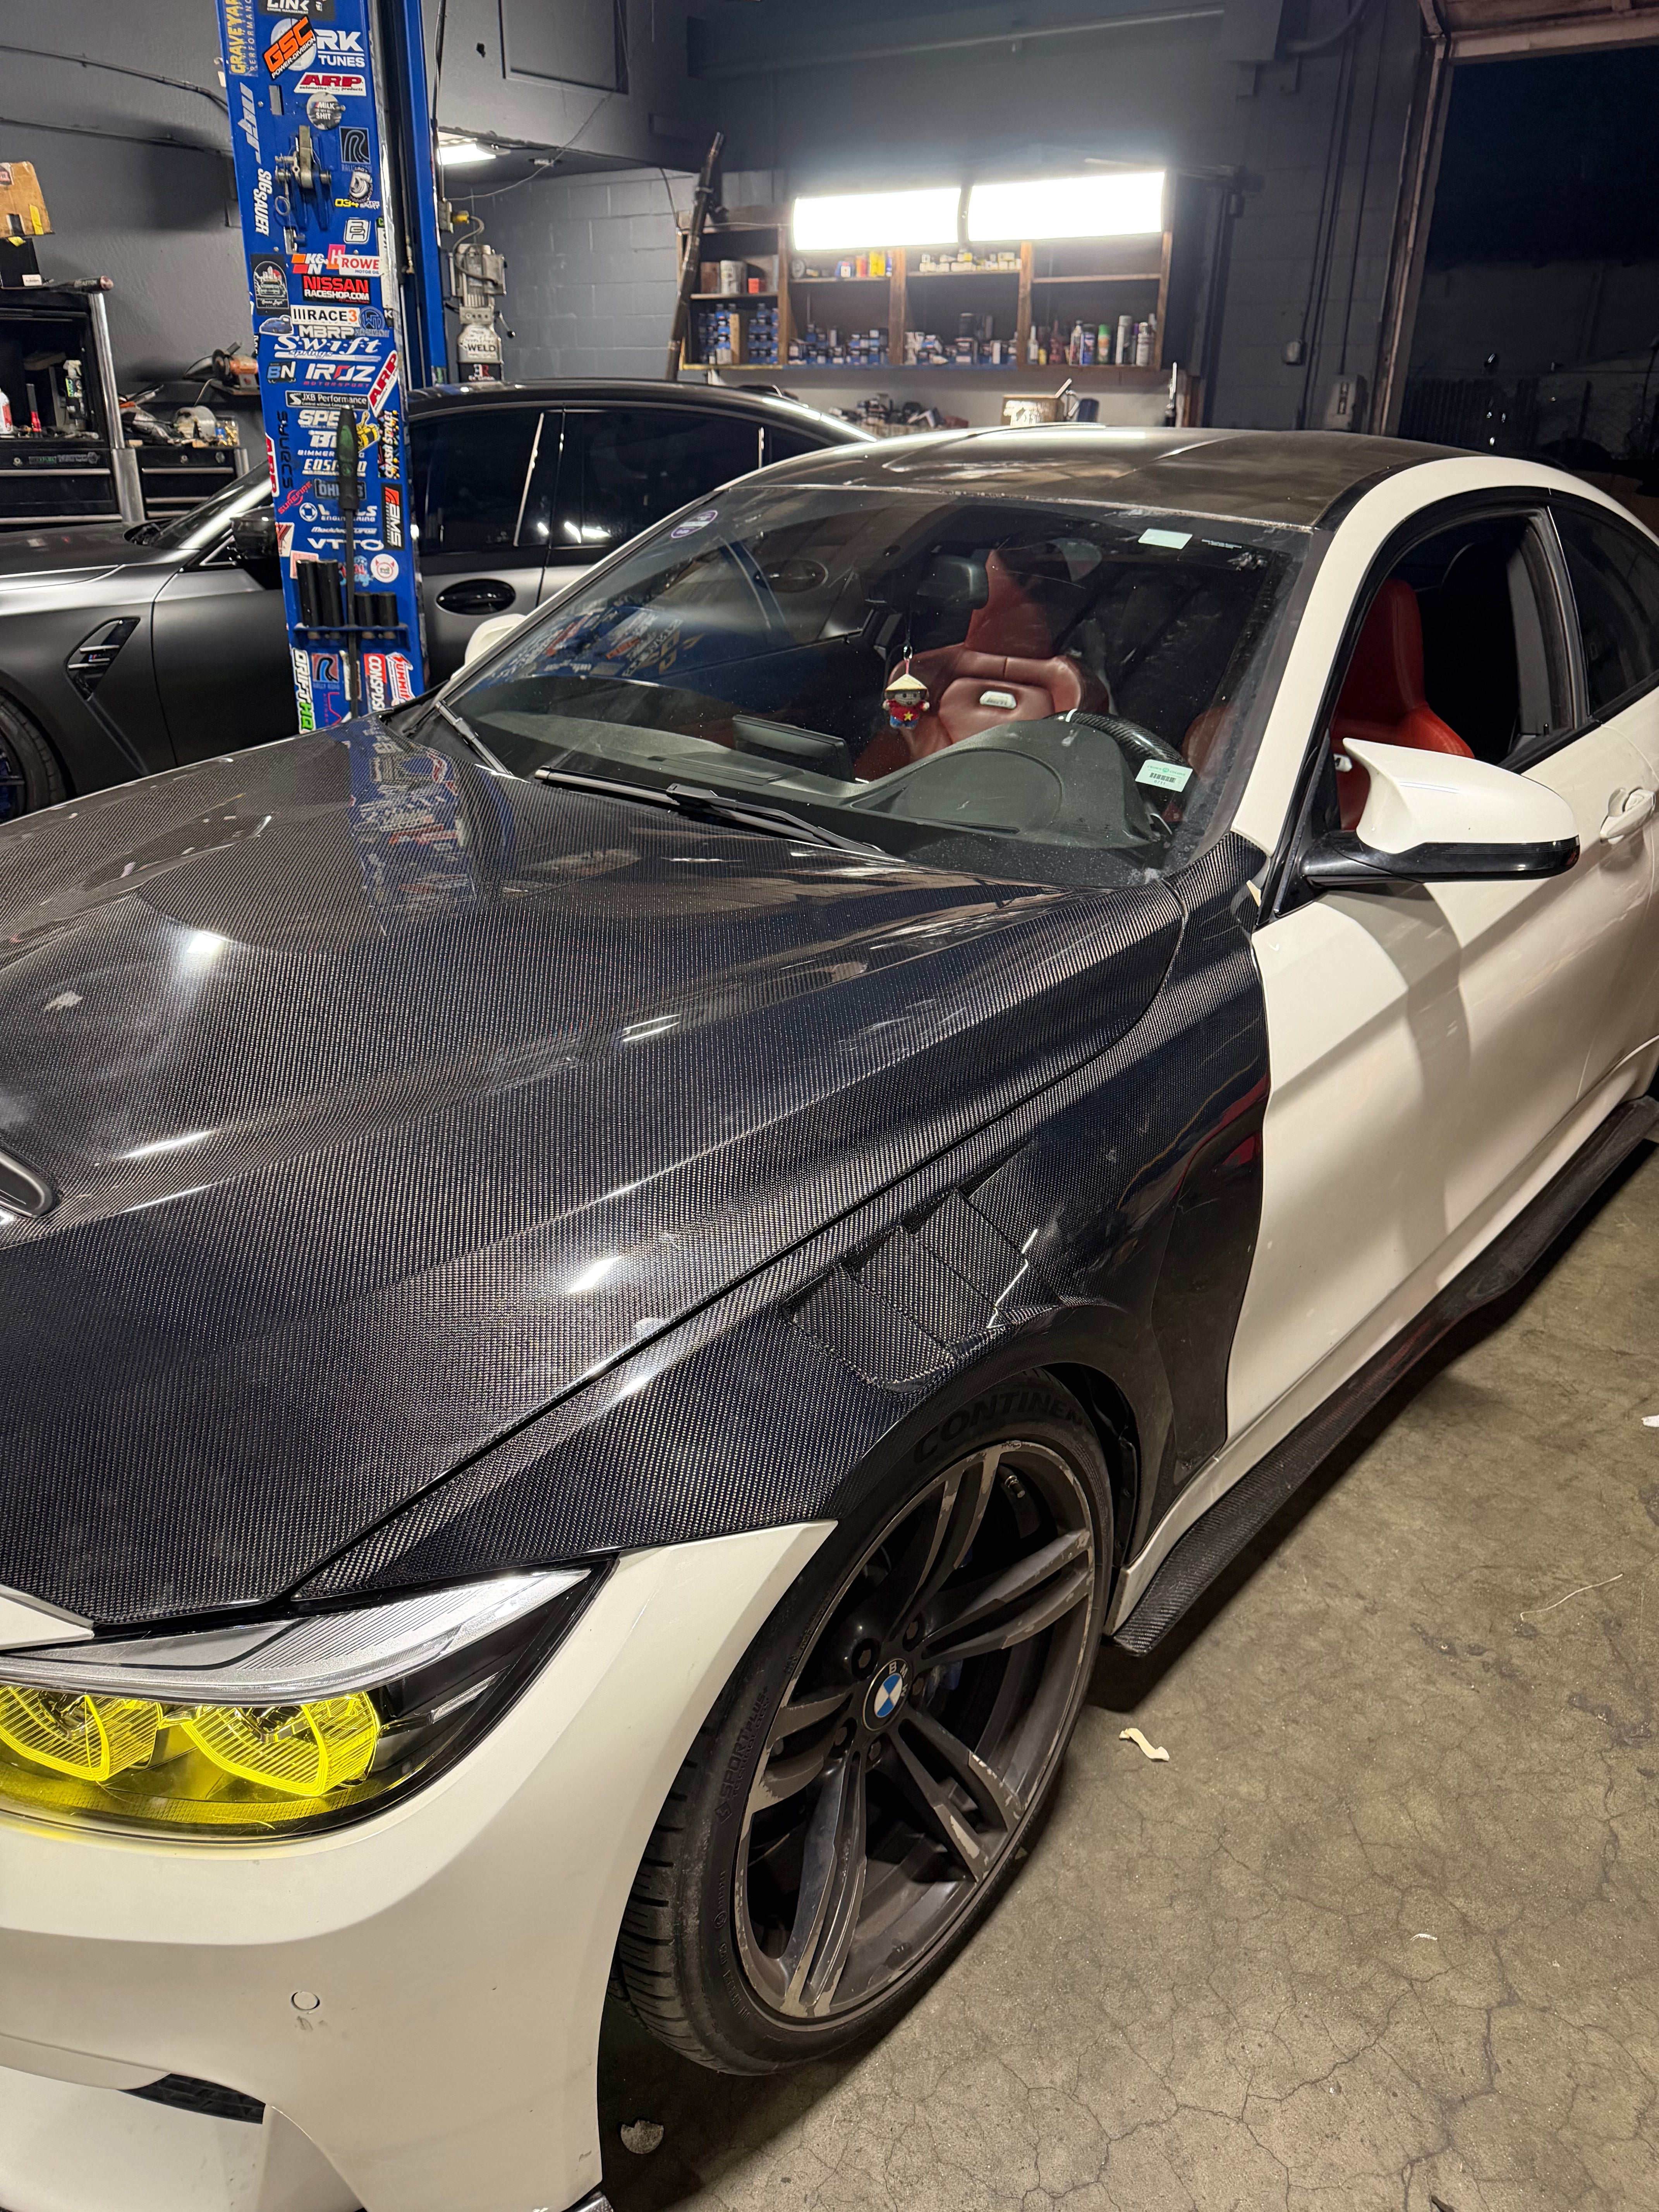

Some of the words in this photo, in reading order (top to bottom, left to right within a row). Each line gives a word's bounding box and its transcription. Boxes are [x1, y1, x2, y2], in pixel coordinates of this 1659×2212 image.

[264, 16, 313, 72] GSC
[314, 29, 364, 52] RK
[318, 55, 365, 67] TUNES
[301, 74, 363, 87] ARP
[257, 168, 273, 195] SIG
[253, 188, 270, 236] SAUER
[341, 258, 380, 270] ROWE
[303, 275, 369, 293] NISSAN
[304, 289, 369, 301] RACESHOP.COM
[299, 325, 354, 339] MBRP
[289, 349, 333, 357] springs
[468, 343, 496, 352] WELD
[301, 393, 316, 402] JXB
[318, 393, 367, 405] Performance
[278, 481, 312, 514] SUREFIRE
[389, 503, 402, 548] AMS
[889, 1661, 909, 1697] BMW
